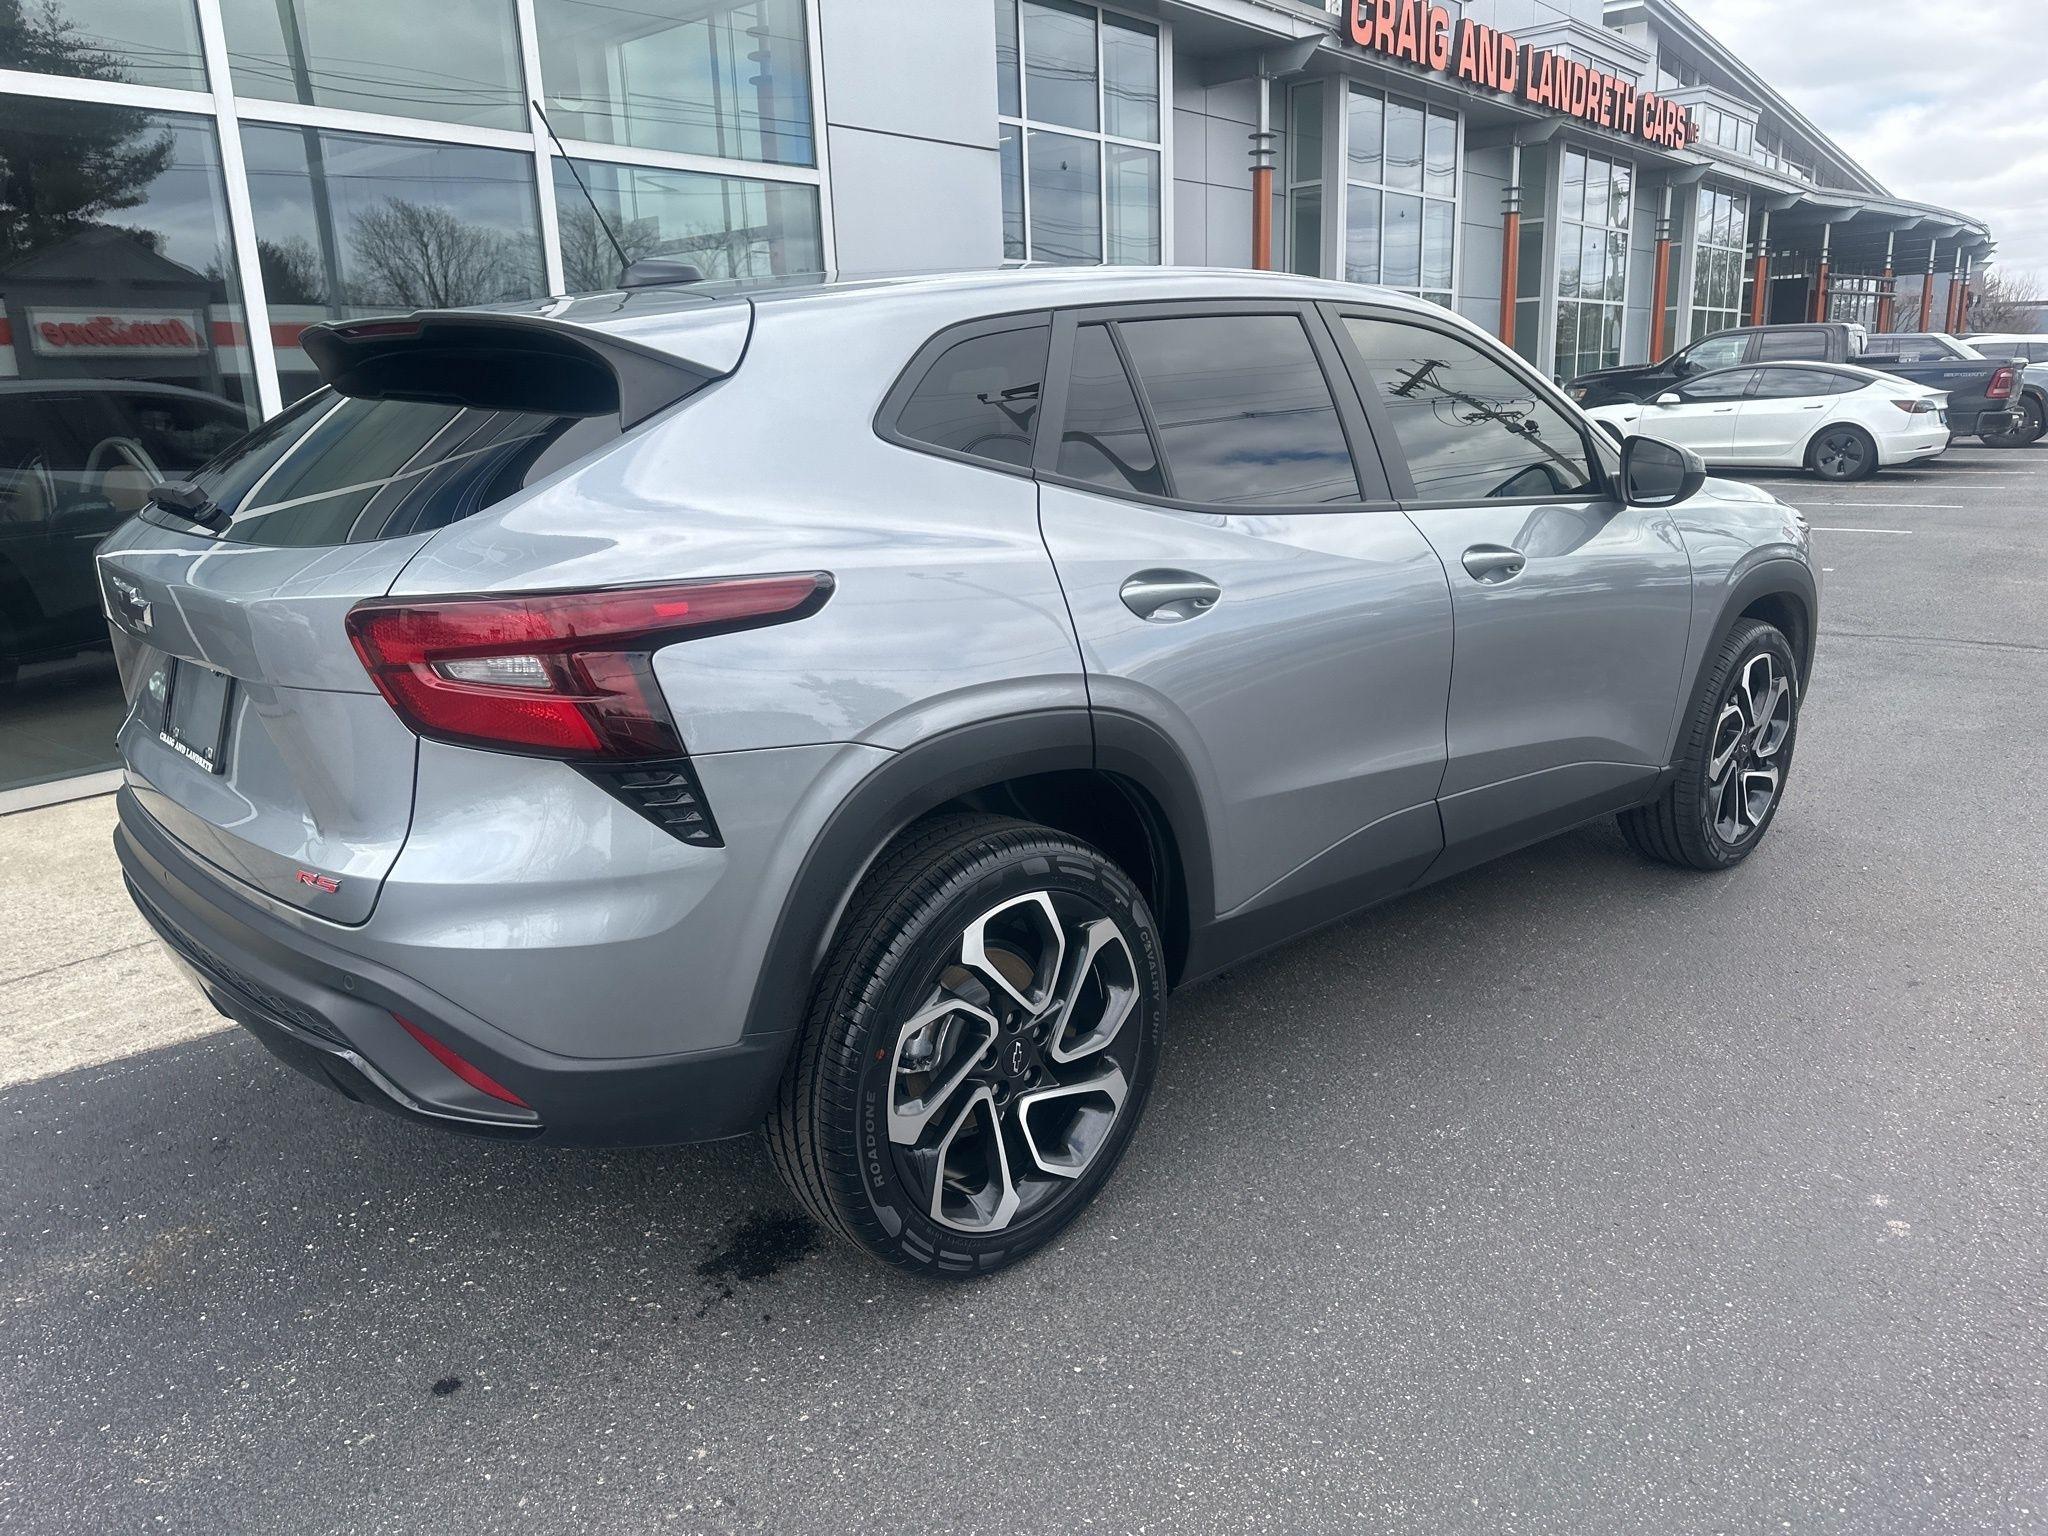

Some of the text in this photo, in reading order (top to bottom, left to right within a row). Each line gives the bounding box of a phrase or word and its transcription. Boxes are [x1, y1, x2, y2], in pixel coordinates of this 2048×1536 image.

[1350, 0, 1449, 71] CRAIG
[1458, 18, 1517, 93] AND
[1527, 44, 1637, 134] LANDRETH
[1643, 92, 1686, 150] CARS
[159, 731, 214, 773] CRAIG AND LANDRETH
[296, 870, 342, 894] RS
[1140, 931, 1160, 1001] CAVALRY
[866, 1091, 885, 1187] ROADONE
